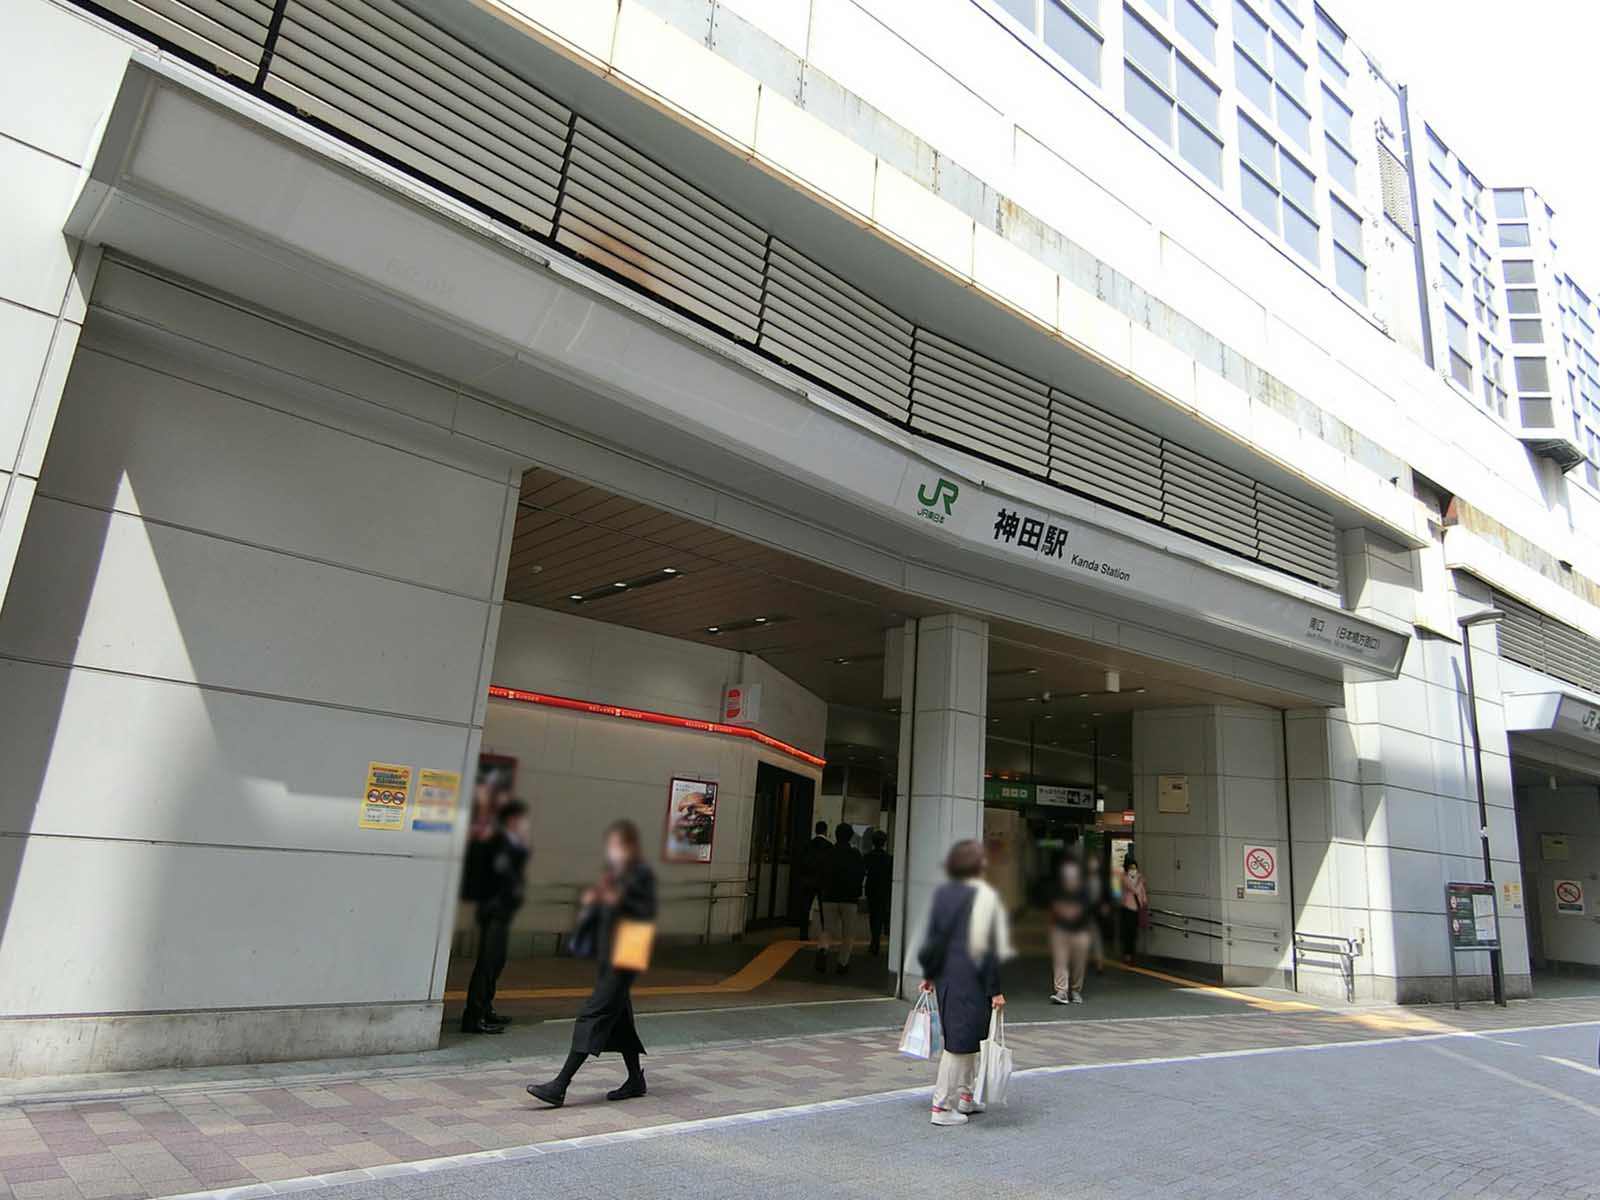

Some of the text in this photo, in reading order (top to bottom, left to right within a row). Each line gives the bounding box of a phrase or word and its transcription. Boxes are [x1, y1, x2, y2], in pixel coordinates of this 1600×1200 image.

[917, 478, 959, 516] JR
[993, 508, 1069, 559] 神田駅
[1070, 554, 1130, 581] Kanda Station
[1583, 710, 1596, 727] JR
